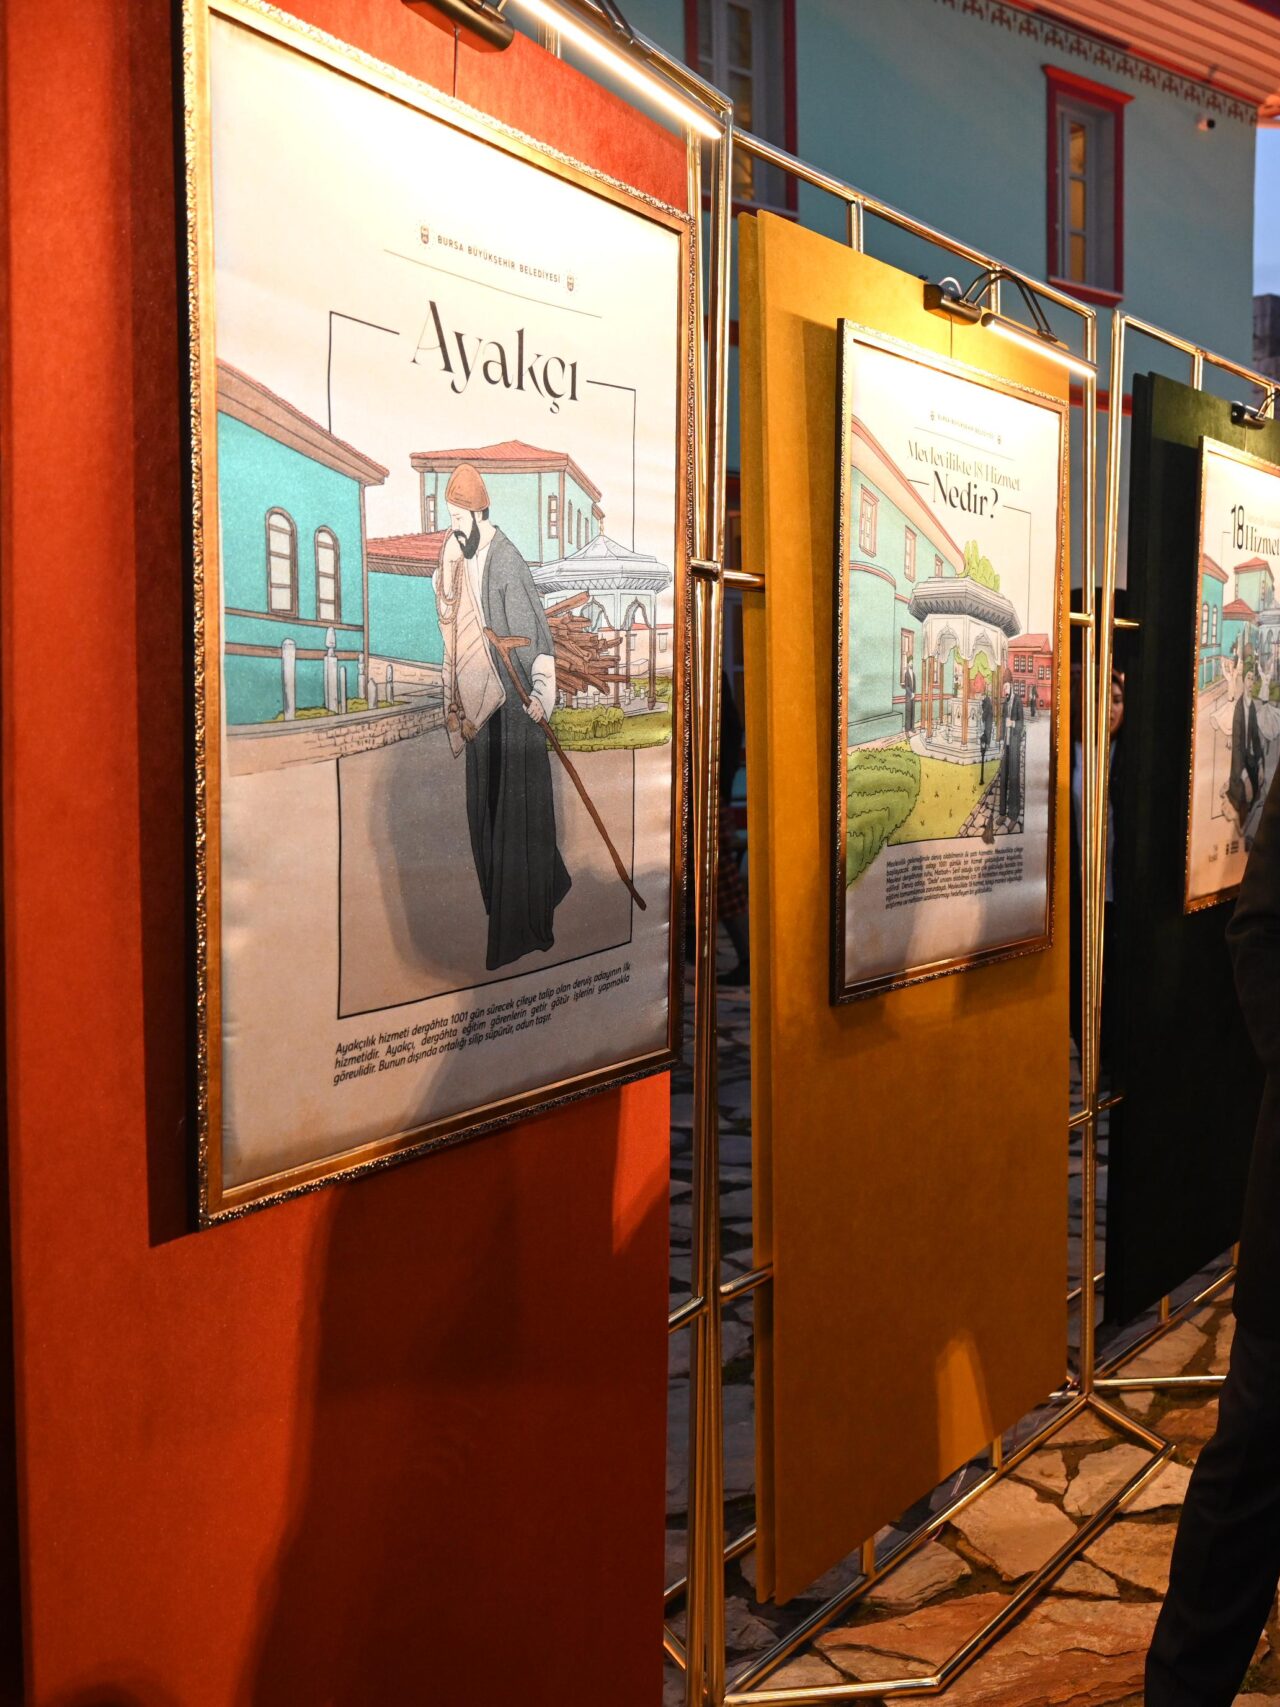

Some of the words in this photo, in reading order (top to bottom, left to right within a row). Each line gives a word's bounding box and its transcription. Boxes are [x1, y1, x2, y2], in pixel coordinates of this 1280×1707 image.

[438, 234, 464, 252] BURSA
[519, 263, 561, 284] BELEDİYESİ
[410, 299, 579, 414] Ayakçı
[908, 439, 971, 476] Mevlevilikte
[985, 463, 1020, 492] Hizmet
[933, 470, 999, 519] Nedir?
[1231, 503, 1244, 550] 18
[1245, 525, 1280, 556] Hizmet
[334, 1049, 380, 1069] hizmetidir.
[385, 1041, 416, 1057] Ayakçı,
[421, 1027, 458, 1046] dergâhta
[462, 1020, 486, 1036] eğitim
[490, 1008, 527, 1029] görenlerin
[530, 1002, 547, 1018] getir
[550, 994, 569, 1011] götür
[597, 974, 630, 995] yapmakla
[335, 1035, 376, 1056] Ayakçılık
[378, 1027, 409, 1044] hizmeti
[411, 1017, 449, 1038] dergâhta
[450, 1011, 468, 1024] 1001
[470, 1008, 485, 1021] gün
[486, 998, 514, 1016] sürecek
[538, 987, 554, 1001] talip
[555, 983, 571, 995] olan
[378, 1056, 406, 1072] Bunun
[407, 1046, 437, 1063] dışında
[438, 1037, 467, 1054] ortalığı
[468, 1033, 484, 1046] silip
[515, 1018, 534, 1031] odun
